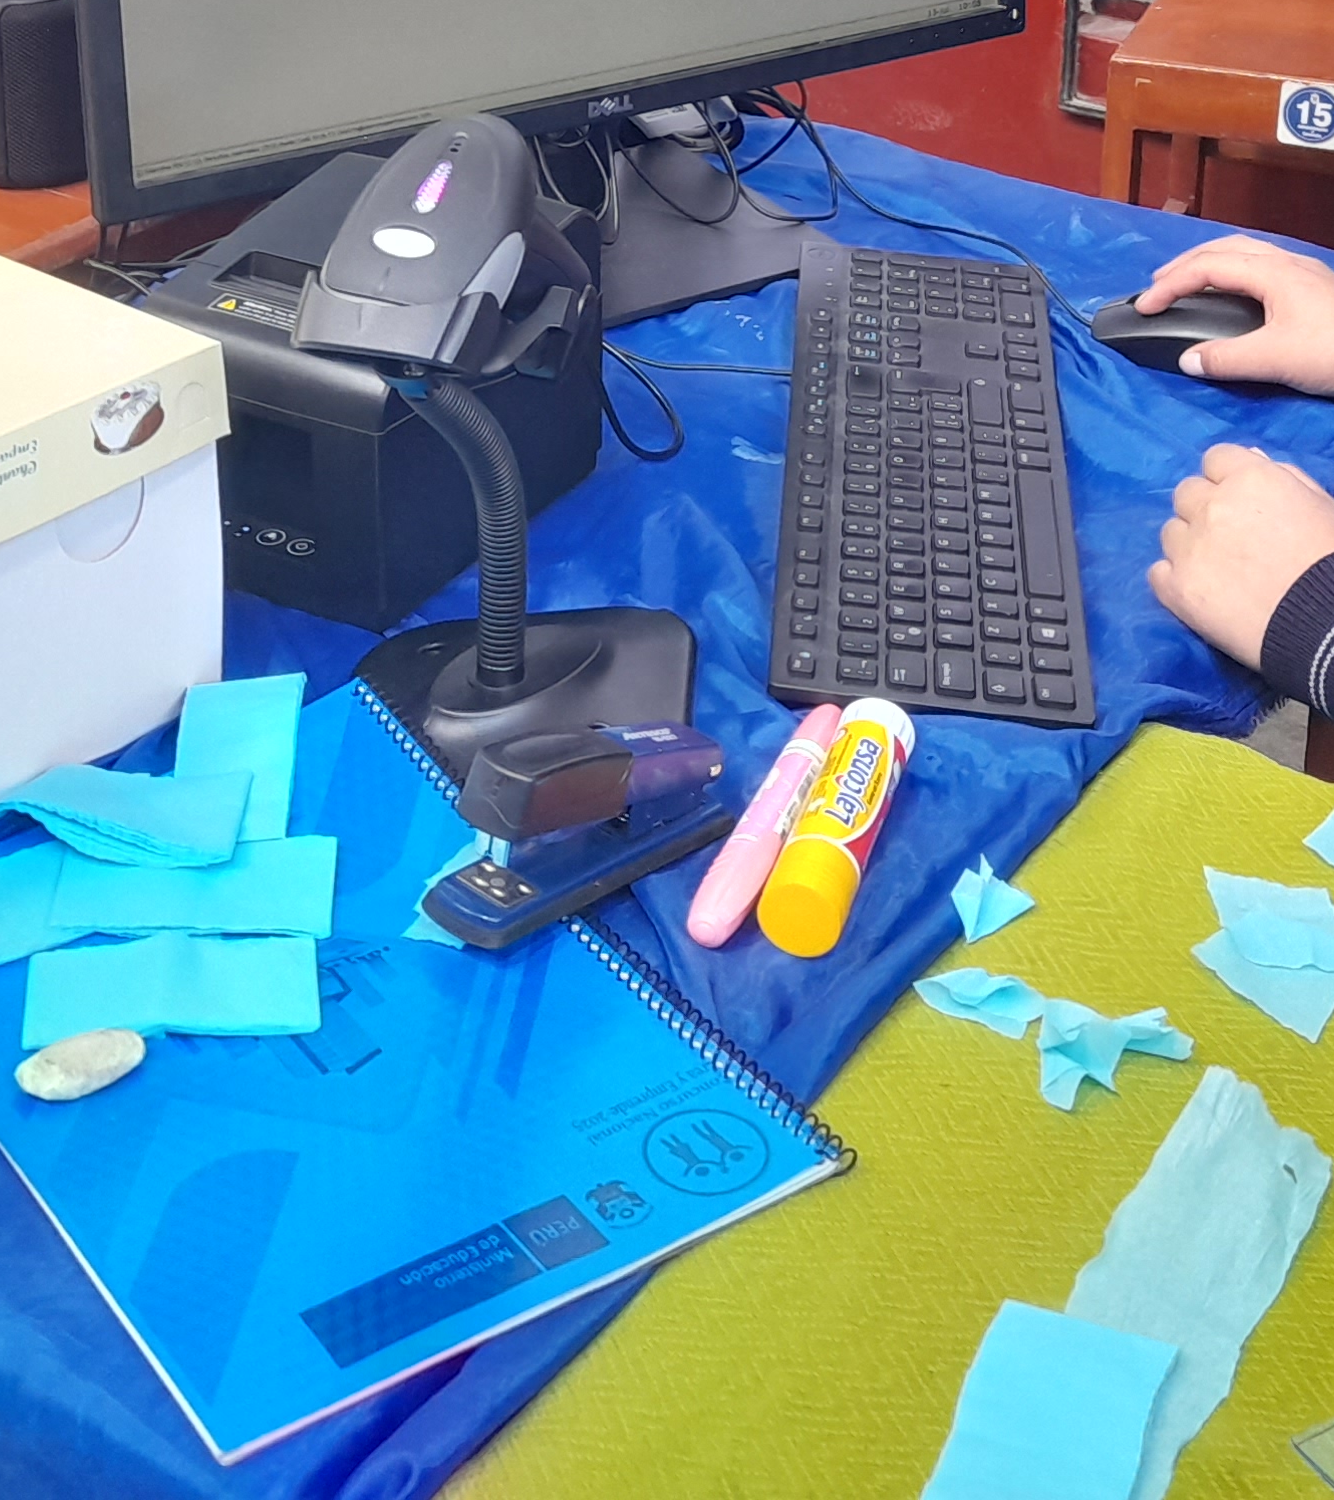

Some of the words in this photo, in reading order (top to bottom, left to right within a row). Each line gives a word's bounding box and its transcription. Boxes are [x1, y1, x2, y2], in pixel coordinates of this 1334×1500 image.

[588, 94, 634, 118] DELL
[1296, 100, 1333, 127] 15
[528, 1214, 582, 1248] PERÚ
[398, 1243, 481, 1288] Educación
[434, 1244, 516, 1290] Ministerio
